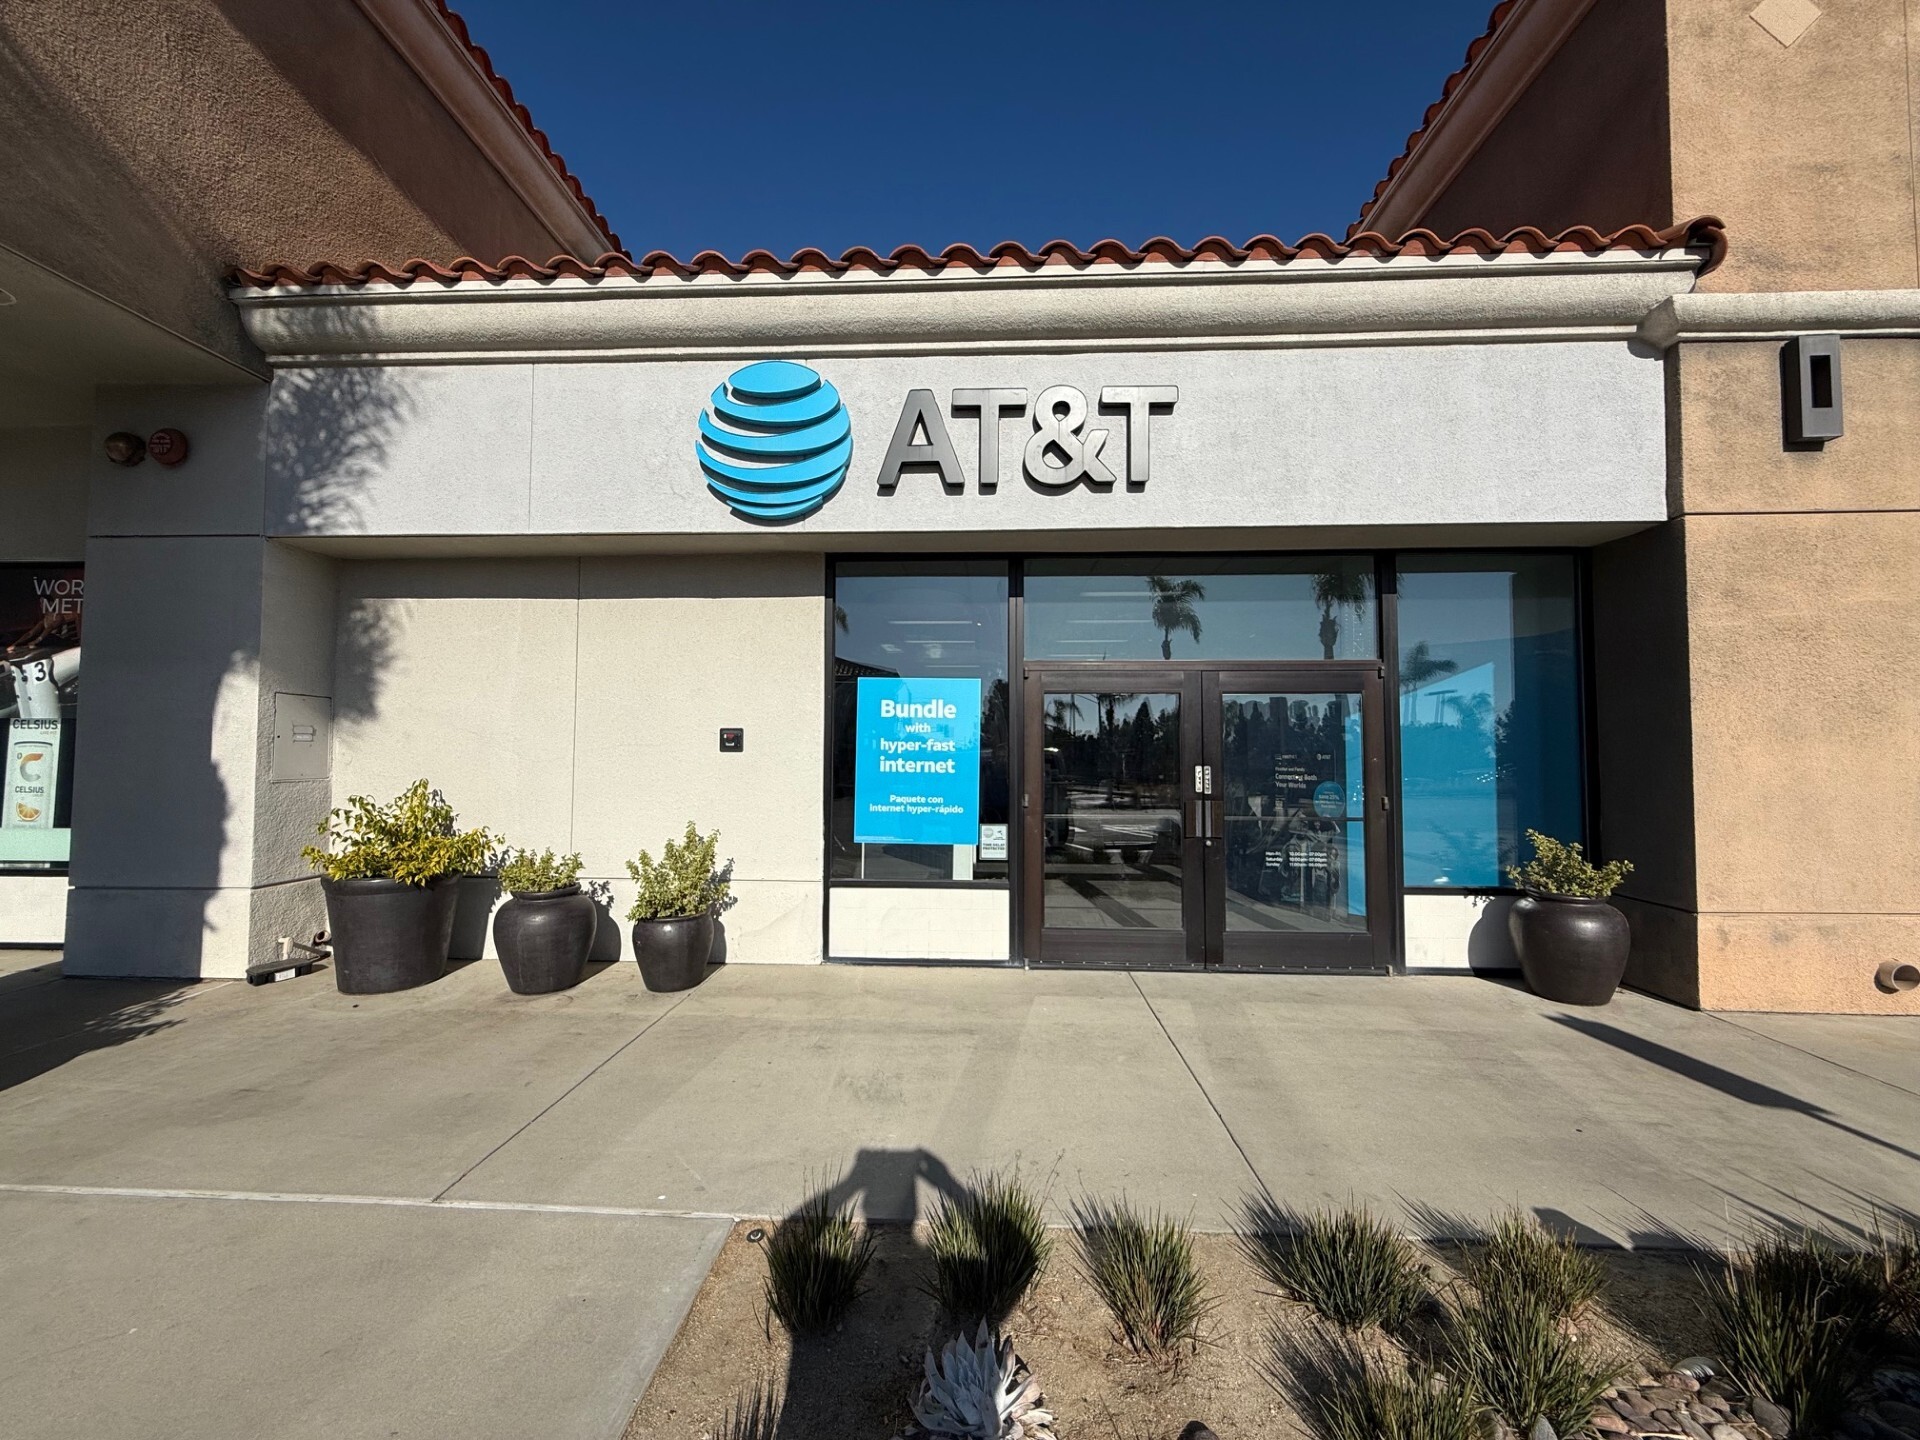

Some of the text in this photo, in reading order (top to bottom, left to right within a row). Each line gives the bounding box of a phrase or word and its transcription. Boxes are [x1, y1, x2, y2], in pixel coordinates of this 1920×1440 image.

[877, 385, 1179, 494] AT&T
[33, 579, 84, 596] WOR
[42, 598, 84, 614] MET
[34, 661, 47, 682] 3
[880, 698, 957, 719] Bundle
[12, 718, 59, 730] CELSIUS
[905, 723, 931, 733] with
[880, 738, 956, 754] hyper-fast
[879, 756, 956, 774] internet
[1275, 773, 1304, 782] Connecting
[14, 786, 45, 794] CELSIUS
[889, 794, 944, 805] Paquete con
[906, 803, 964, 815] hyper-rápido
